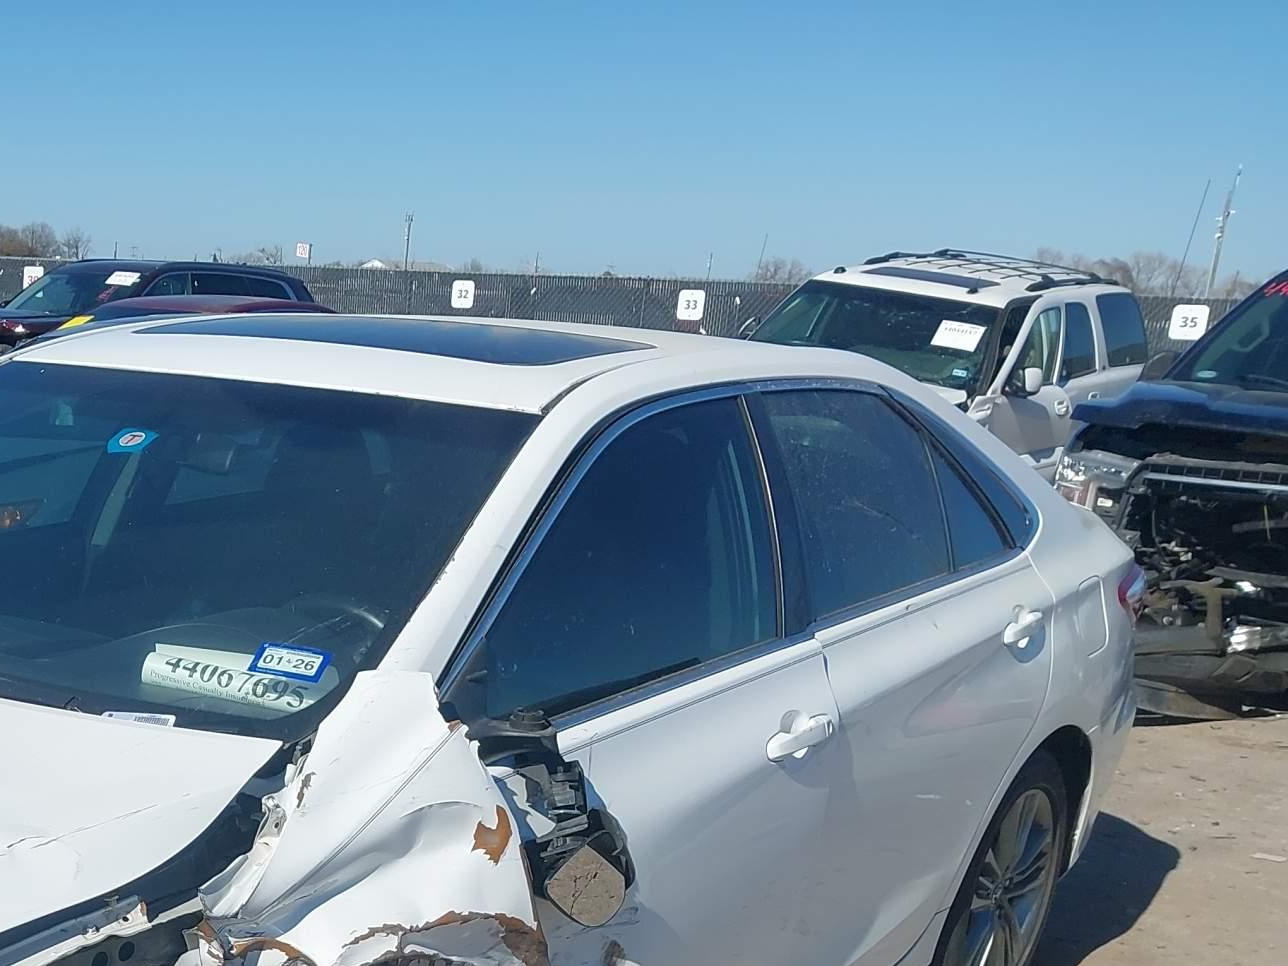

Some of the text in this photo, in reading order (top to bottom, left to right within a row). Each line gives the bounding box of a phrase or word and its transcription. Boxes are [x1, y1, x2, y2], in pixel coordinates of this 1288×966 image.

[457, 289, 469, 299] 32
[684, 299, 698, 310] 33
[1179, 316, 1199, 328] 35
[262, 654, 316, 671] 01 26
[165, 657, 309, 709] 44067695
